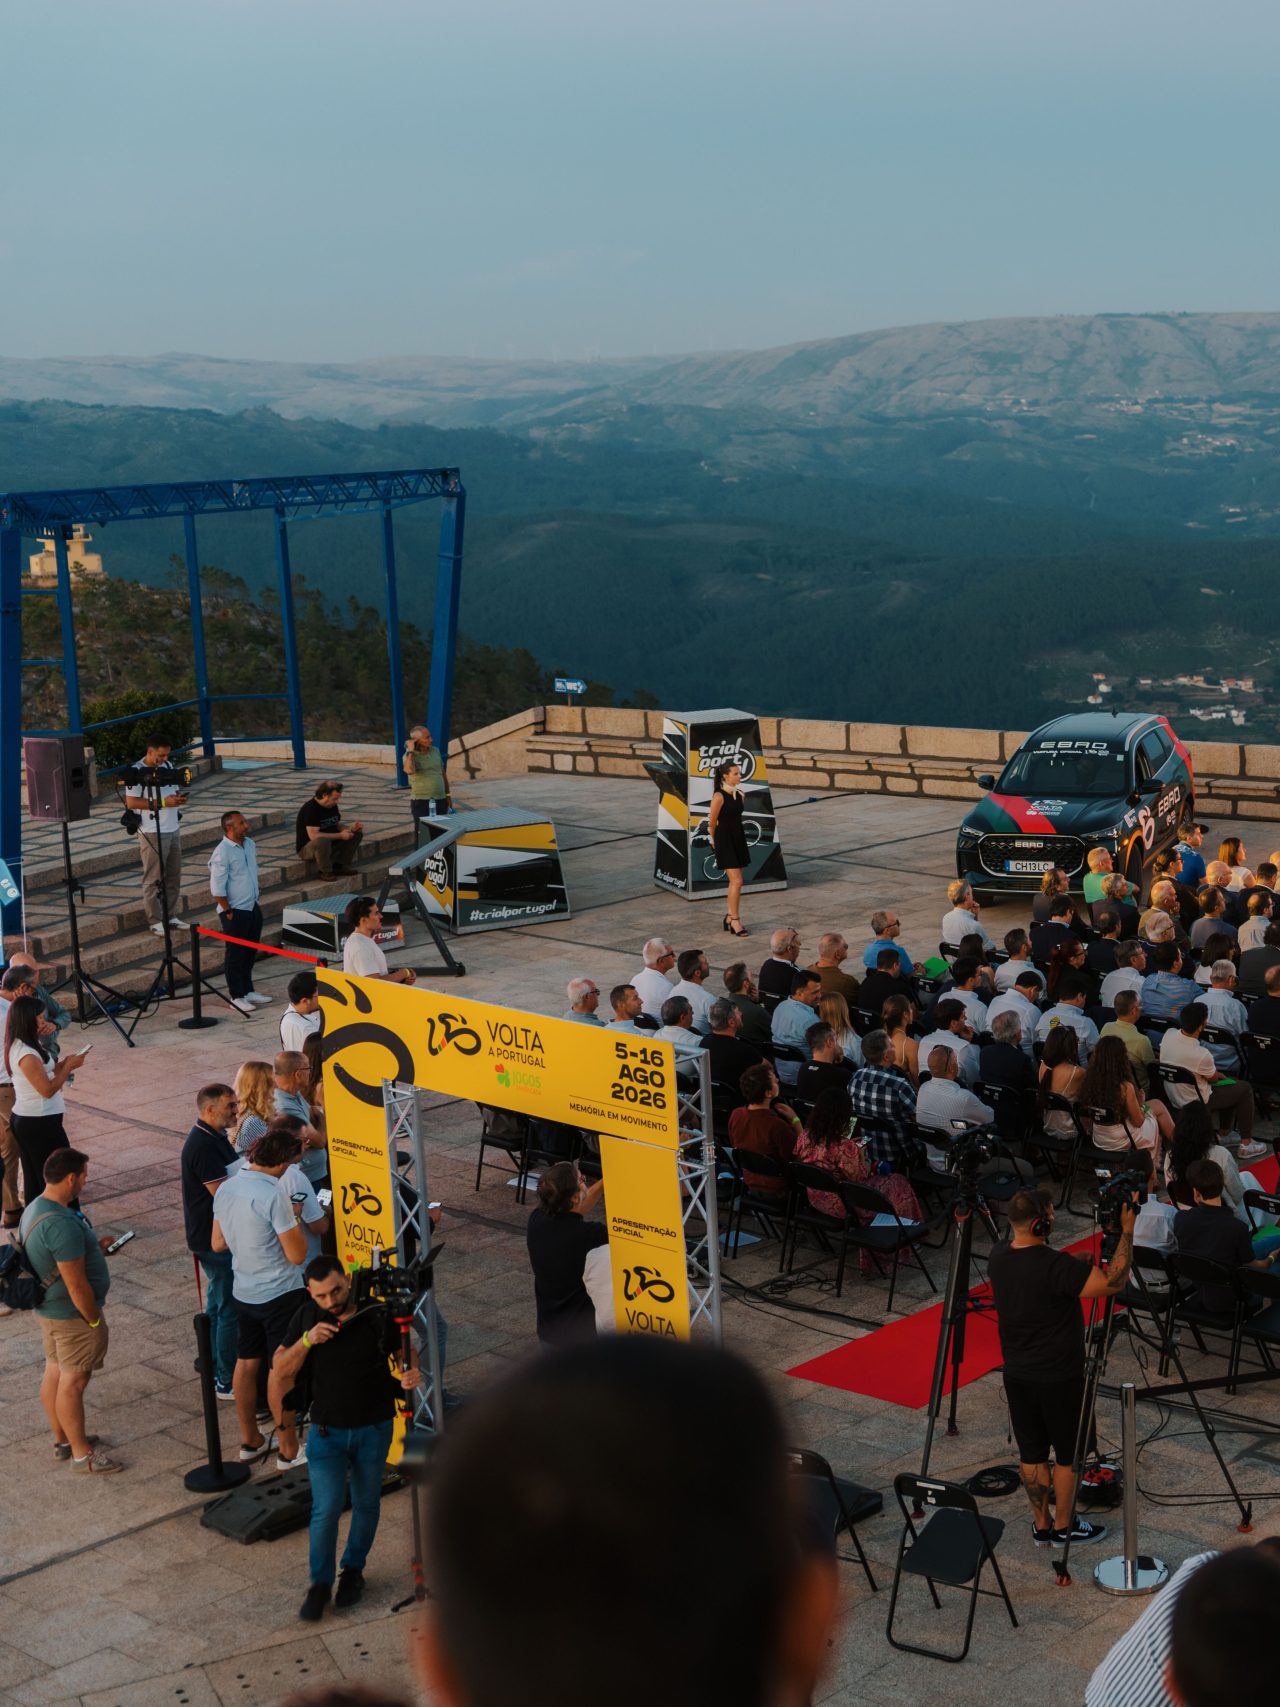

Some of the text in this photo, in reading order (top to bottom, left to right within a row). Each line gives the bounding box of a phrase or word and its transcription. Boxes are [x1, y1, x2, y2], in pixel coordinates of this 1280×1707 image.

[699, 737, 742, 756] trial
[1040, 741, 1108, 750] EBRO
[699, 754, 742, 771] port
[1157, 786, 1180, 818] EBRO
[424, 858, 443, 873] port
[428, 869, 446, 885] ugal
[469, 900, 557, 921] #trialportugal
[486, 1020, 545, 1054] VOLTA
[488, 1047, 546, 1069] A PORTUGAL
[615, 1041, 665, 1068] 5-16
[512, 1071, 542, 1089] JOGOS
[618, 1063, 665, 1089] AGO
[611, 1082, 667, 1110] 2026
[569, 1102, 668, 1132] MEMÓRIA EM MOVIMENTO
[331, 1137, 383, 1157] APRESENTAÇÃO
[332, 1145, 358, 1157] OFICIAL
[343, 1221, 385, 1249] VOLTA
[612, 1217, 677, 1239] APRESENTAÇÃO
[612, 1225, 644, 1239] OFICIAL
[345, 1241, 373, 1256] A PORTU
[625, 1307, 677, 1338] VOLTA
